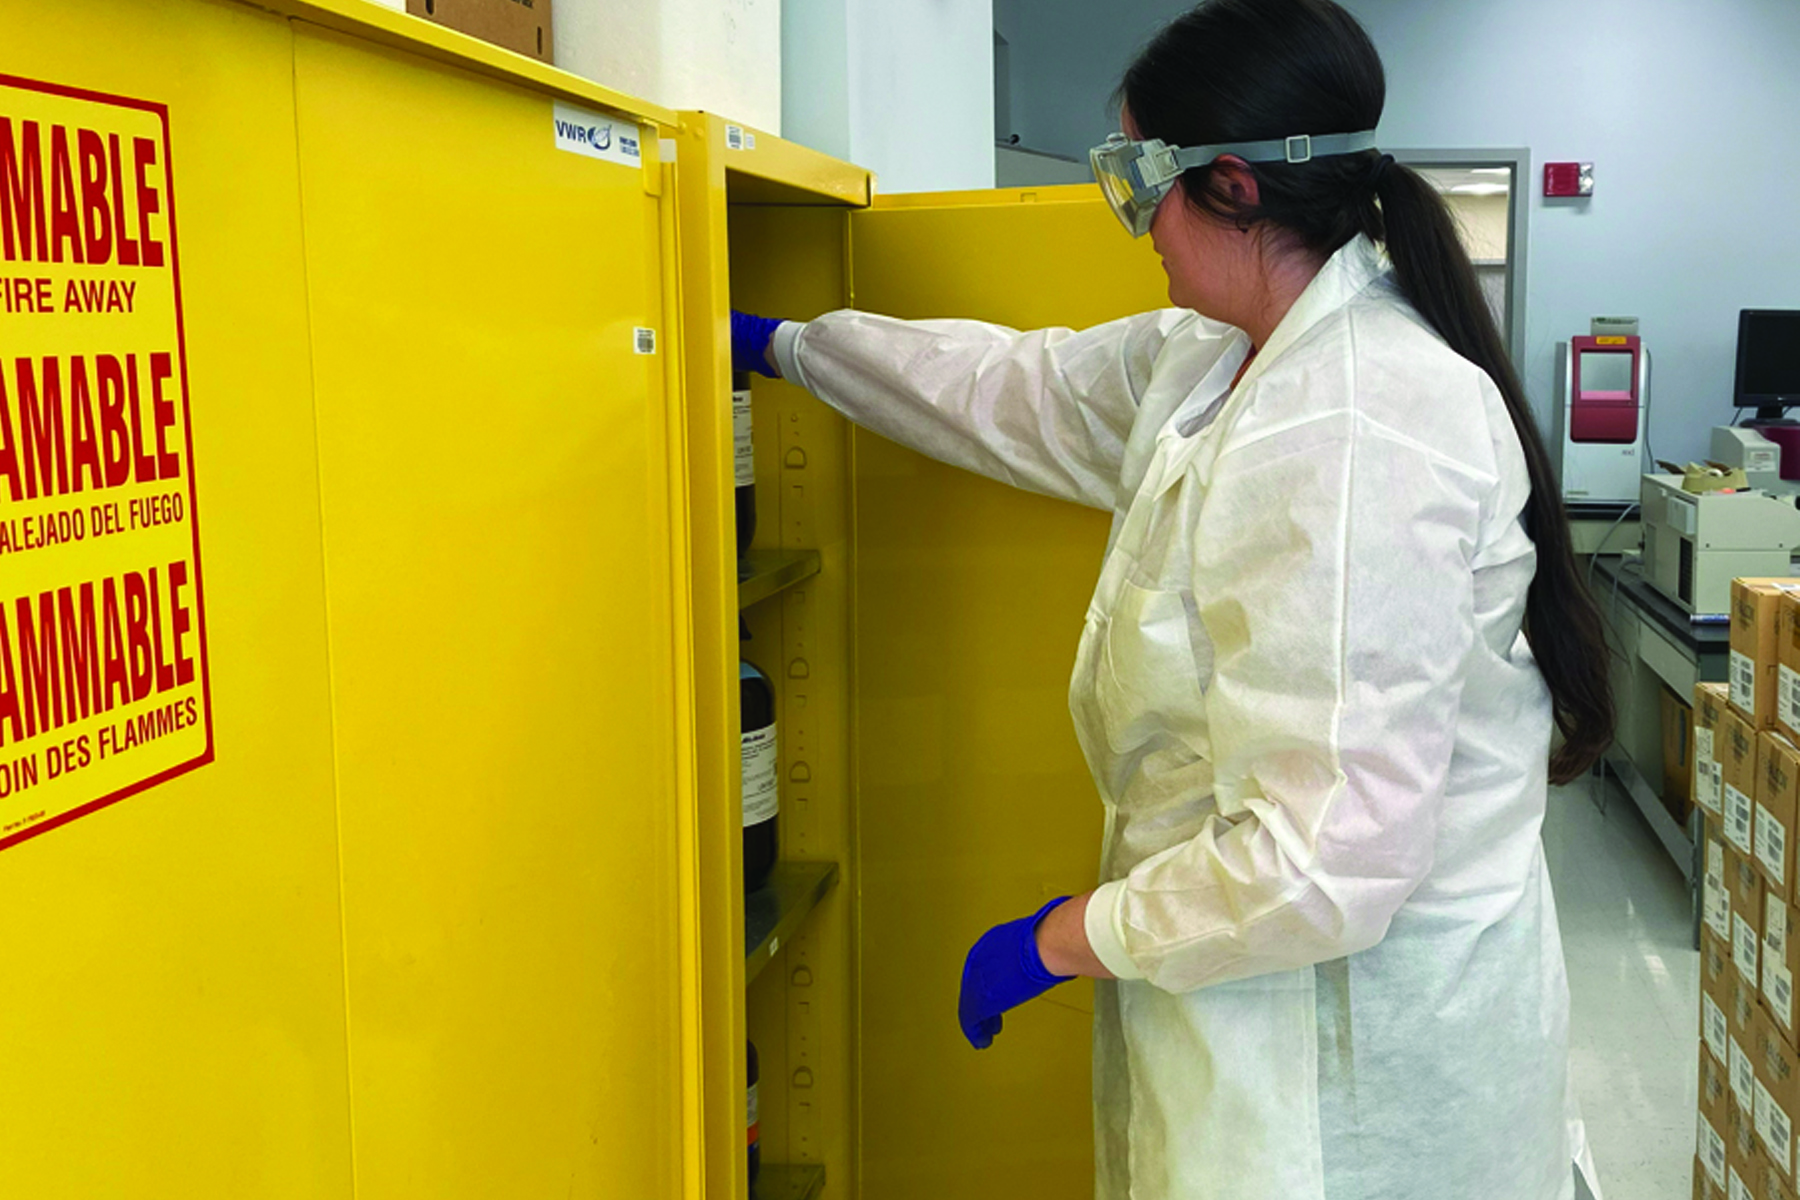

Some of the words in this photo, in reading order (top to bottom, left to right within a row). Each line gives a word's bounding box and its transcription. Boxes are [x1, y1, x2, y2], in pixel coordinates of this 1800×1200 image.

[555, 119, 586, 143] VWR
[0, 278, 54, 313] IRE
[64, 279, 136, 313] AWAY
[0, 508, 85, 555] ALEJADO
[90, 502, 125, 538] DEL
[129, 492, 184, 531] FUEGO
[46, 734, 91, 780] DES
[98, 696, 198, 760] FLAMMES
